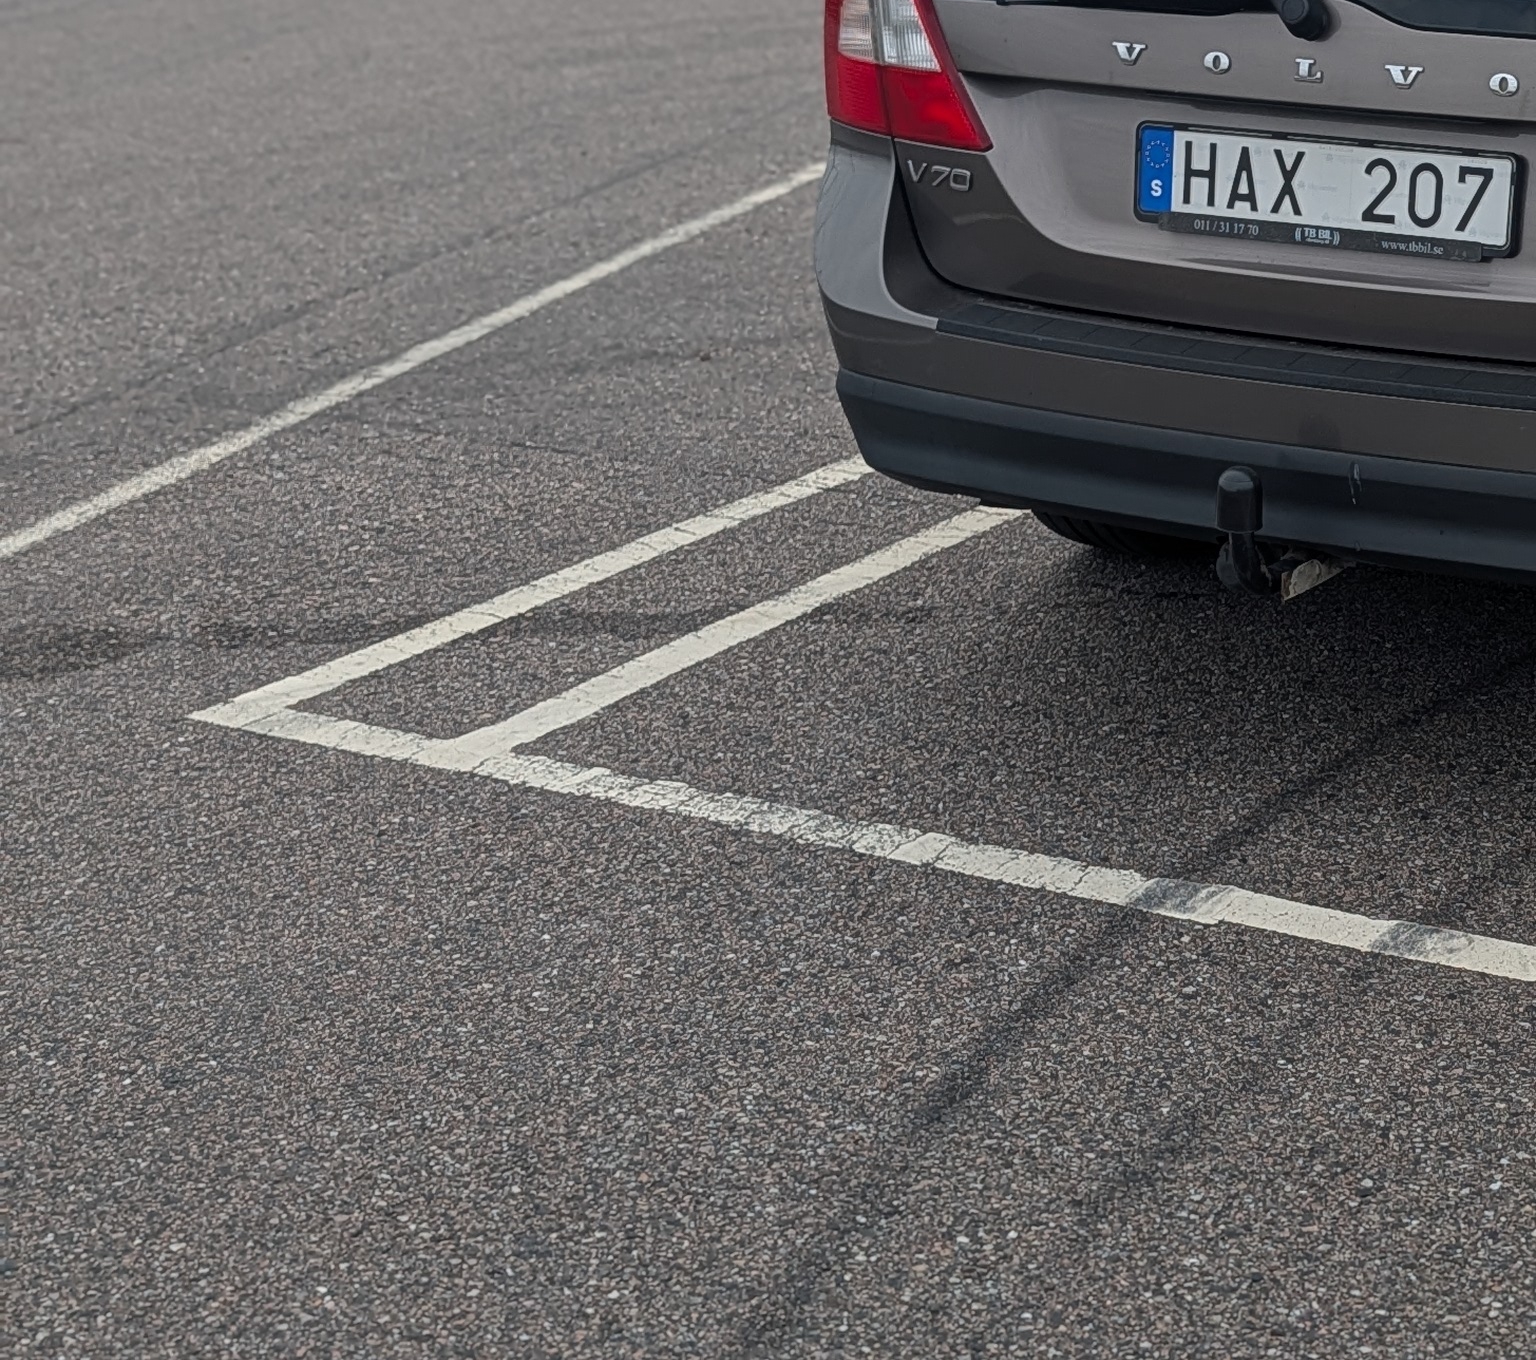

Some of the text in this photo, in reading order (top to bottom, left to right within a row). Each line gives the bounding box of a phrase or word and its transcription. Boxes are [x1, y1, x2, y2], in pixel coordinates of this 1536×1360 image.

[1112, 41, 1520, 97] VOLVO
[907, 159, 971, 192] V70
[1150, 179, 1163, 197] S
[1182, 140, 1494, 232] HAX 207
[1381, 240, 1444, 255] www.tbbil.se
